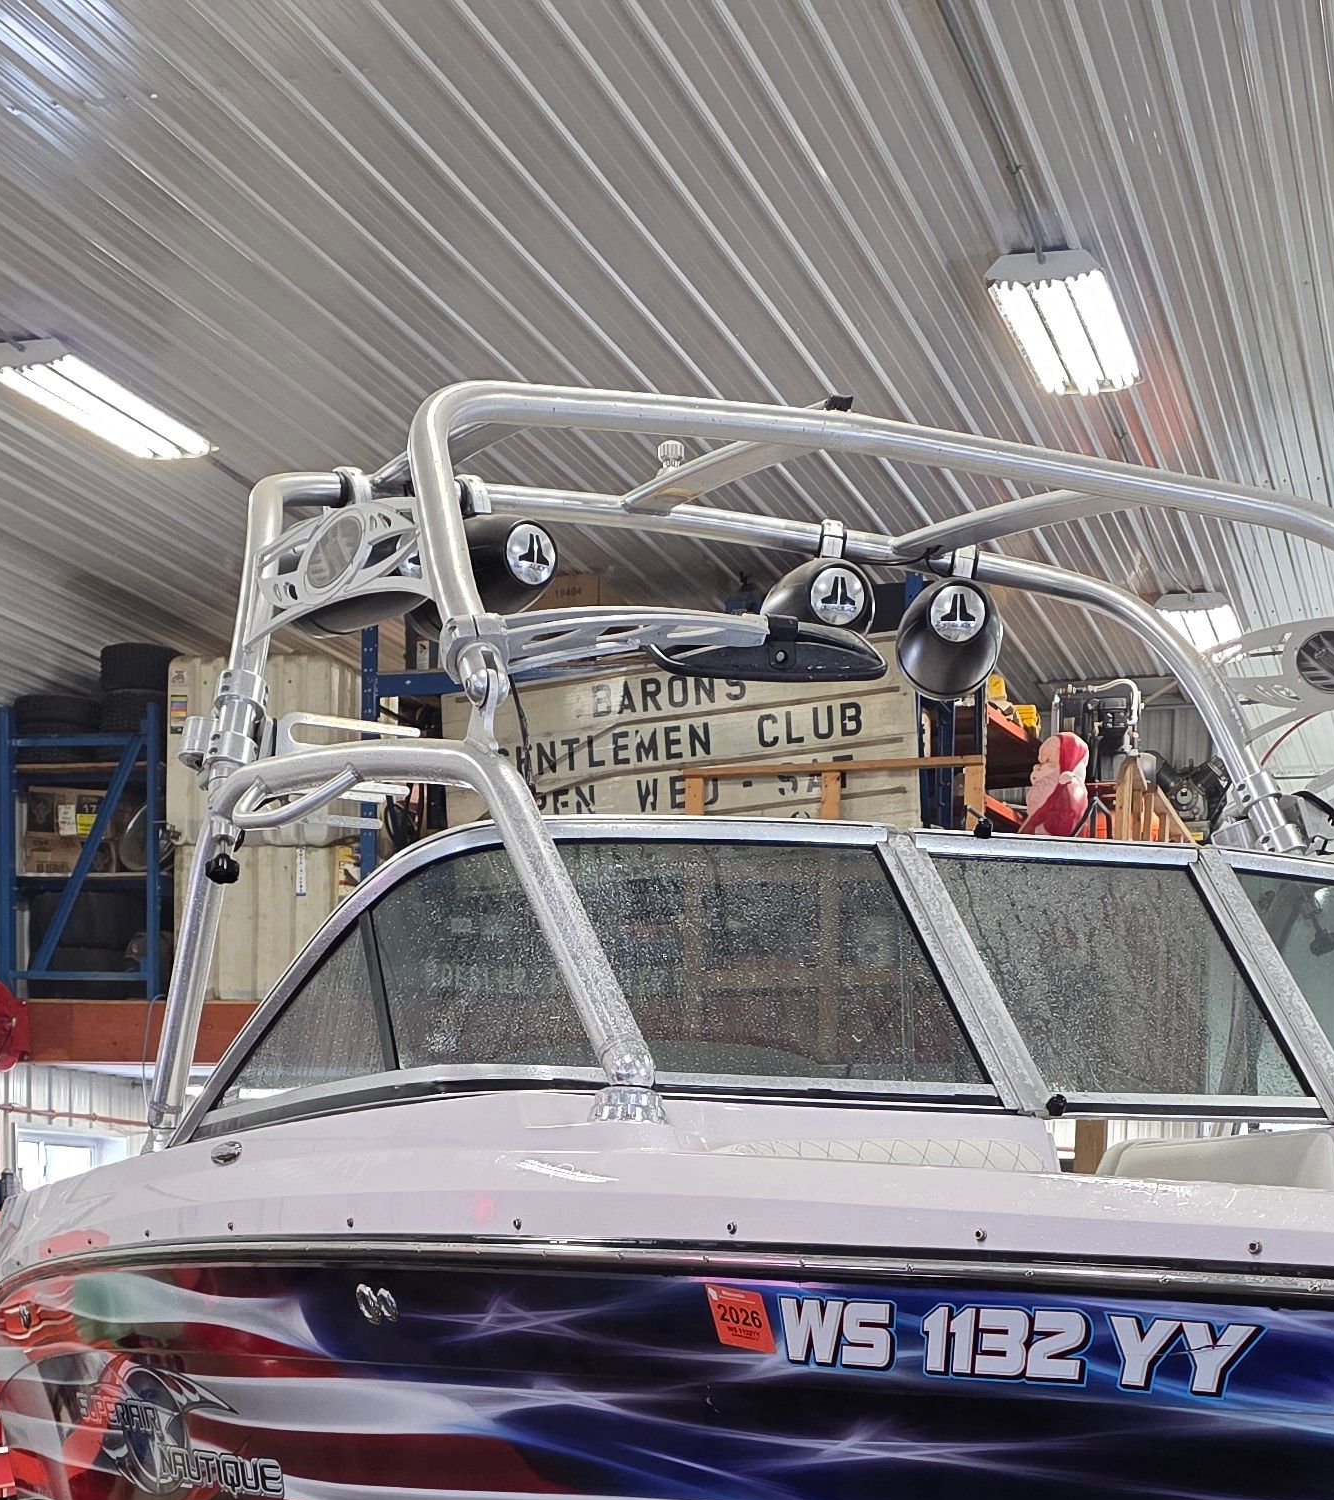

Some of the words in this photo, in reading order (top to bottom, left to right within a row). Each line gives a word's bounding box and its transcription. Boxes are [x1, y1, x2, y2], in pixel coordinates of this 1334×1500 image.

[592, 674, 747, 718] BARONS
[498, 722, 712, 780] ENTLEMEN
[757, 702, 863, 749] CLUB
[717, 1303, 763, 1329] 2026
[778, 1295, 896, 1370] WS
[921, 1304, 1087, 1385] 1132
[1107, 1314, 1264, 1397] YY
[157, 1442, 285, 1499] NAUTIQUE
